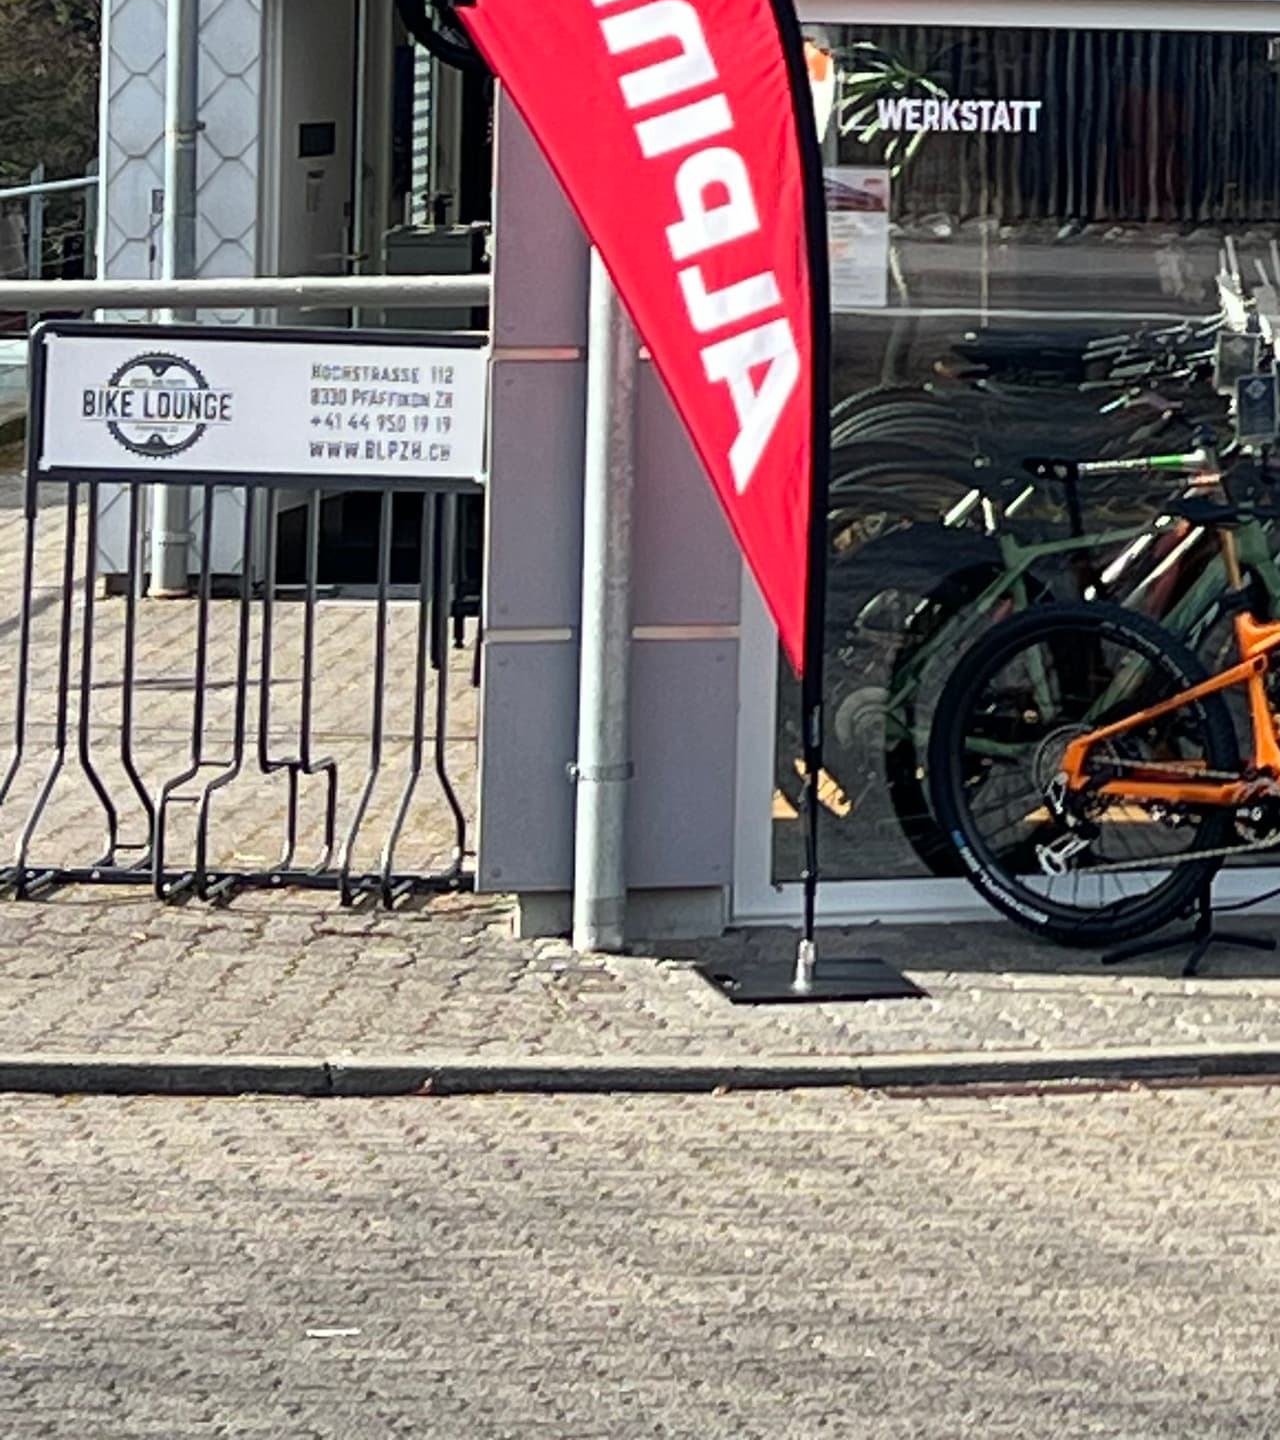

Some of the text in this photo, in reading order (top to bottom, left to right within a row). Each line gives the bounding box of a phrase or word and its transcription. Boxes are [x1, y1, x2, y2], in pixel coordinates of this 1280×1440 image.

[877, 97, 1042, 133] WERKSTATT
[431, 365, 454, 384] 112
[82, 389, 233, 421] BIKE LOUNGE
[310, 387, 347, 406] 8330
[310, 412, 452, 434] +41 44 950 19 19
